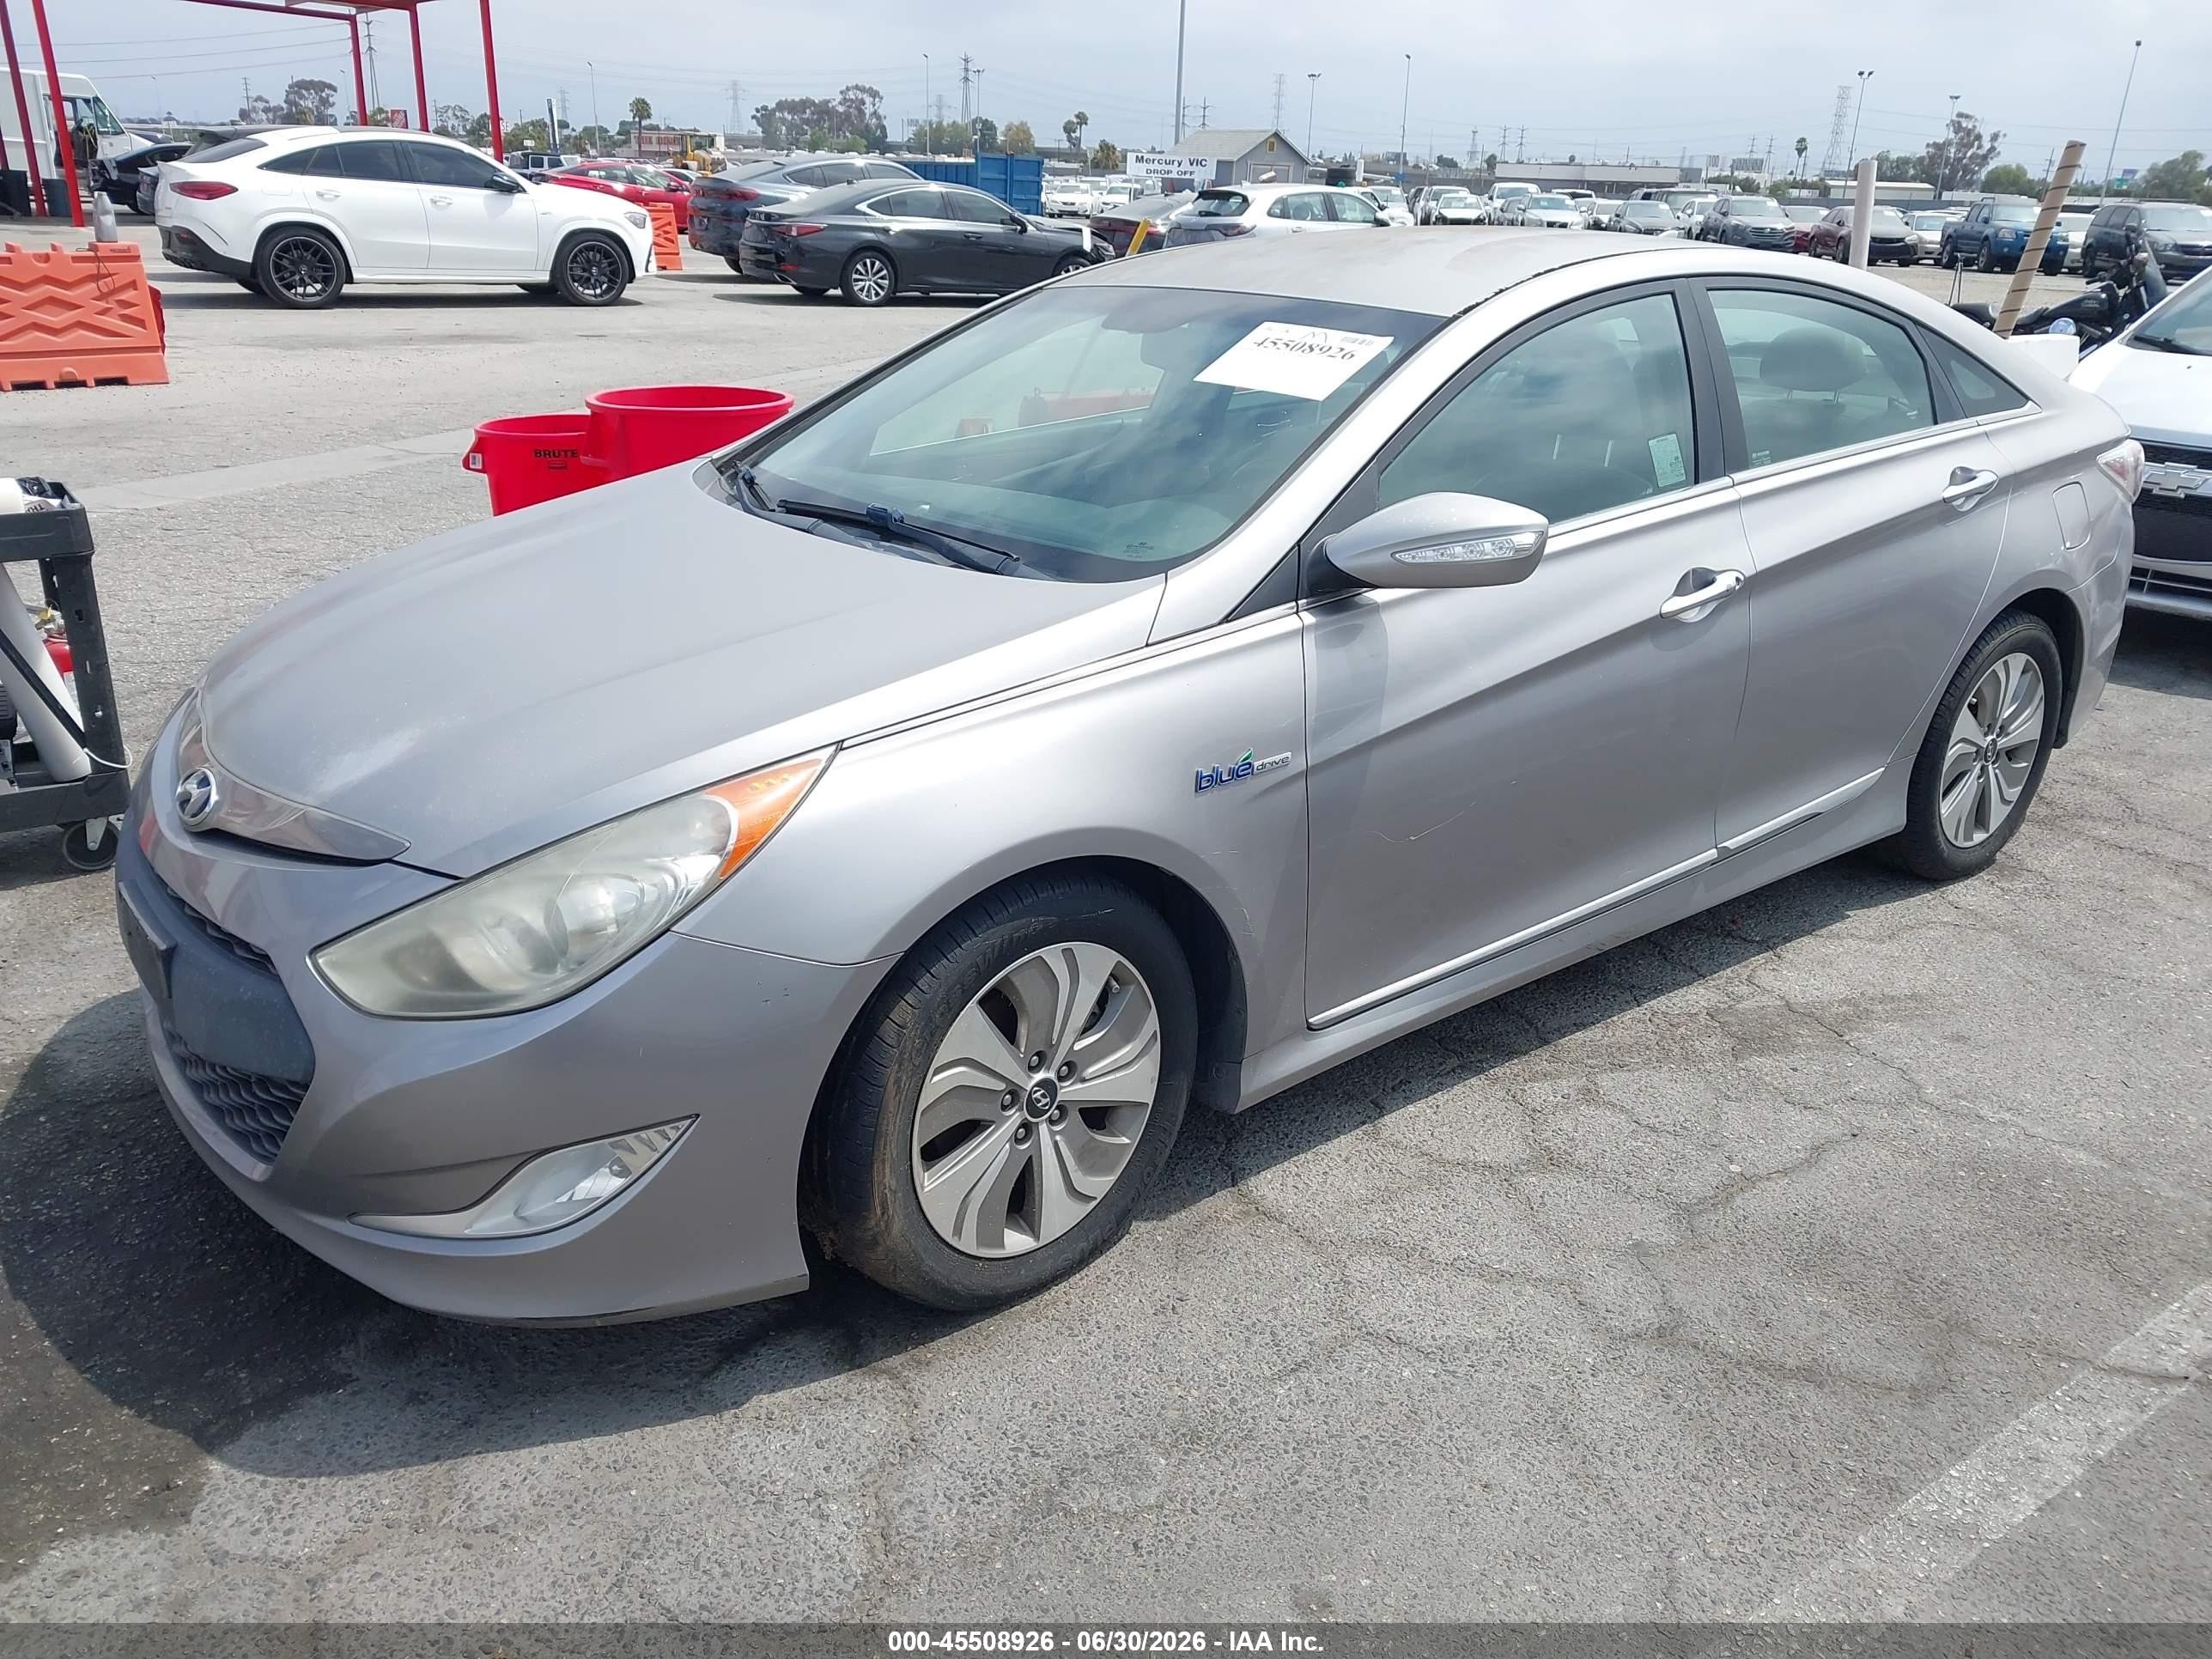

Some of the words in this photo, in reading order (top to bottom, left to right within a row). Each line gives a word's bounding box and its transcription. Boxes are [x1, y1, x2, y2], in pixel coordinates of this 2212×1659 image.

[1134, 155, 1183, 167] Mercury
[1188, 158, 1208, 167] VIC
[1253, 336, 1356, 362] 45508926
[534, 449, 579, 459] BRUTE
[1195, 760, 1254, 793] blue
[1256, 756, 1290, 772] drive
